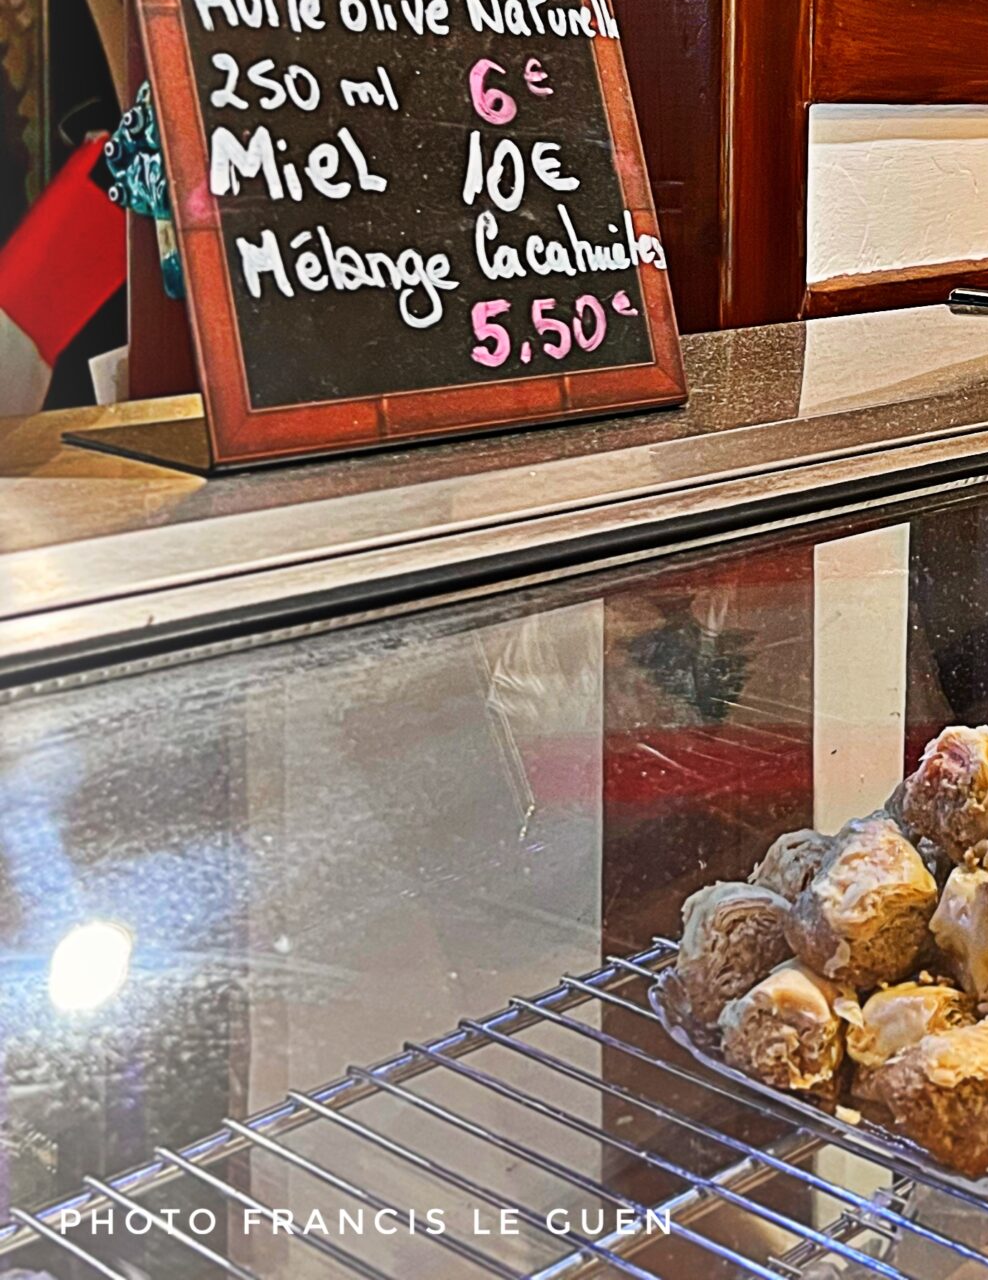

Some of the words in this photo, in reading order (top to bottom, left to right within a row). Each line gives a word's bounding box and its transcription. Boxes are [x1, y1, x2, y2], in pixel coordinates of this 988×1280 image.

[210, 53, 321, 111] 250
[342, 66, 399, 111] ml
[236, 226, 460, 329] Mélange
